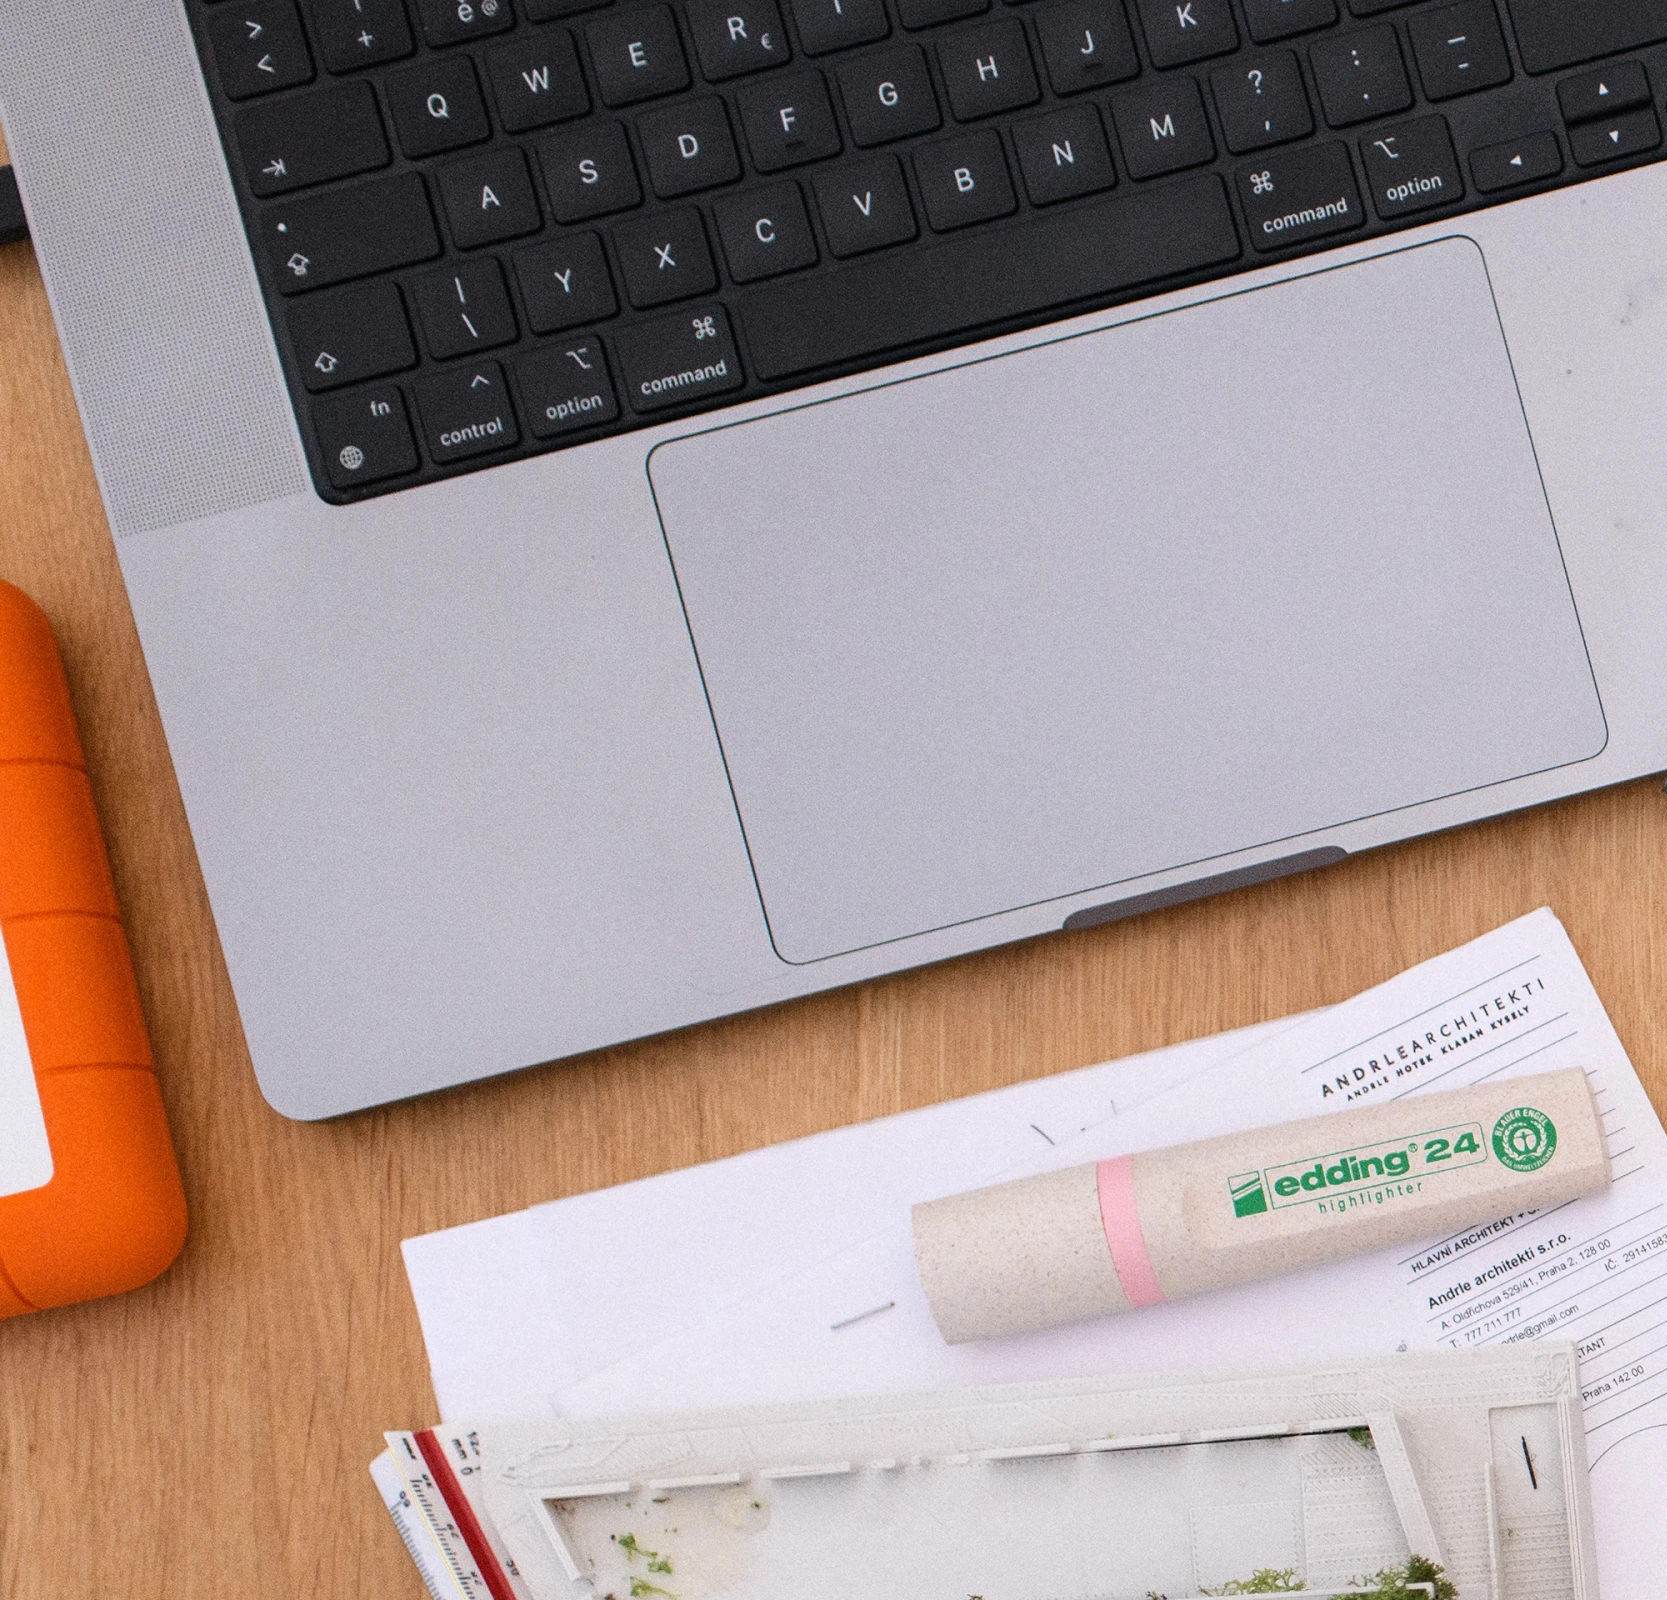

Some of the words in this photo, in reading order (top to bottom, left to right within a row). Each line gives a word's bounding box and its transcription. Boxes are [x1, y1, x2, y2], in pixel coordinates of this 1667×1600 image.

[1177, 3, 1196, 27] K
[728, 17, 747, 40] R
[629, 42, 646, 66] E
[1081, 31, 1093, 54] J
[523, 67, 548, 92] W
[977, 56, 998, 80] H
[879, 82, 898, 105] G
[1248, 70, 1262, 93] ?
[427, 94, 448, 117] Q
[780, 108, 794, 131] F
[1150, 115, 1174, 140] M
[678, 135, 698, 158] D
[1053, 141, 1073, 165] N
[579, 160, 598, 183] S
[955, 168, 974, 191] B
[482, 186, 500, 209] A
[1387, 176, 1442, 200] option
[853, 192, 870, 215] V
[1263, 198, 1347, 233] command
[756, 219, 774, 242] C
[655, 244, 675, 268] X
[555, 269, 570, 292] Y
[641, 360, 726, 394] command
[369, 397, 391, 418] fn
[546, 395, 602, 419] option
[441, 417, 502, 446] control
[1322, 978, 1544, 1098] ANDRLEARCHITEKTI
[1424, 1132, 1480, 1163] 24
[1318, 1182, 1421, 1213] highlighter
[1411, 1244, 1452, 1273] HLAVNÍ
[1455, 1215, 1514, 1252] ARCHITEKT
[1429, 1282, 1471, 1309] Andrle
[1474, 1247, 1535, 1286] architekti
[1537, 1234, 1571, 1254] s.r.o.
[1538, 1263, 1567, 1281] Praha
[1579, 1246, 1597, 1260] 128
[1597, 1238, 1611, 1251] 00
[1464, 1327, 1481, 1342] 777
[1483, 1318, 1502, 1332] 711
[1504, 1307, 1521, 1322] 777
[1577, 1337, 1605, 1359] TANT
[1581, 1383, 1611, 1402] Praha
[1612, 1372, 1631, 1386] 142
[1631, 1365, 1644, 1377] 00
